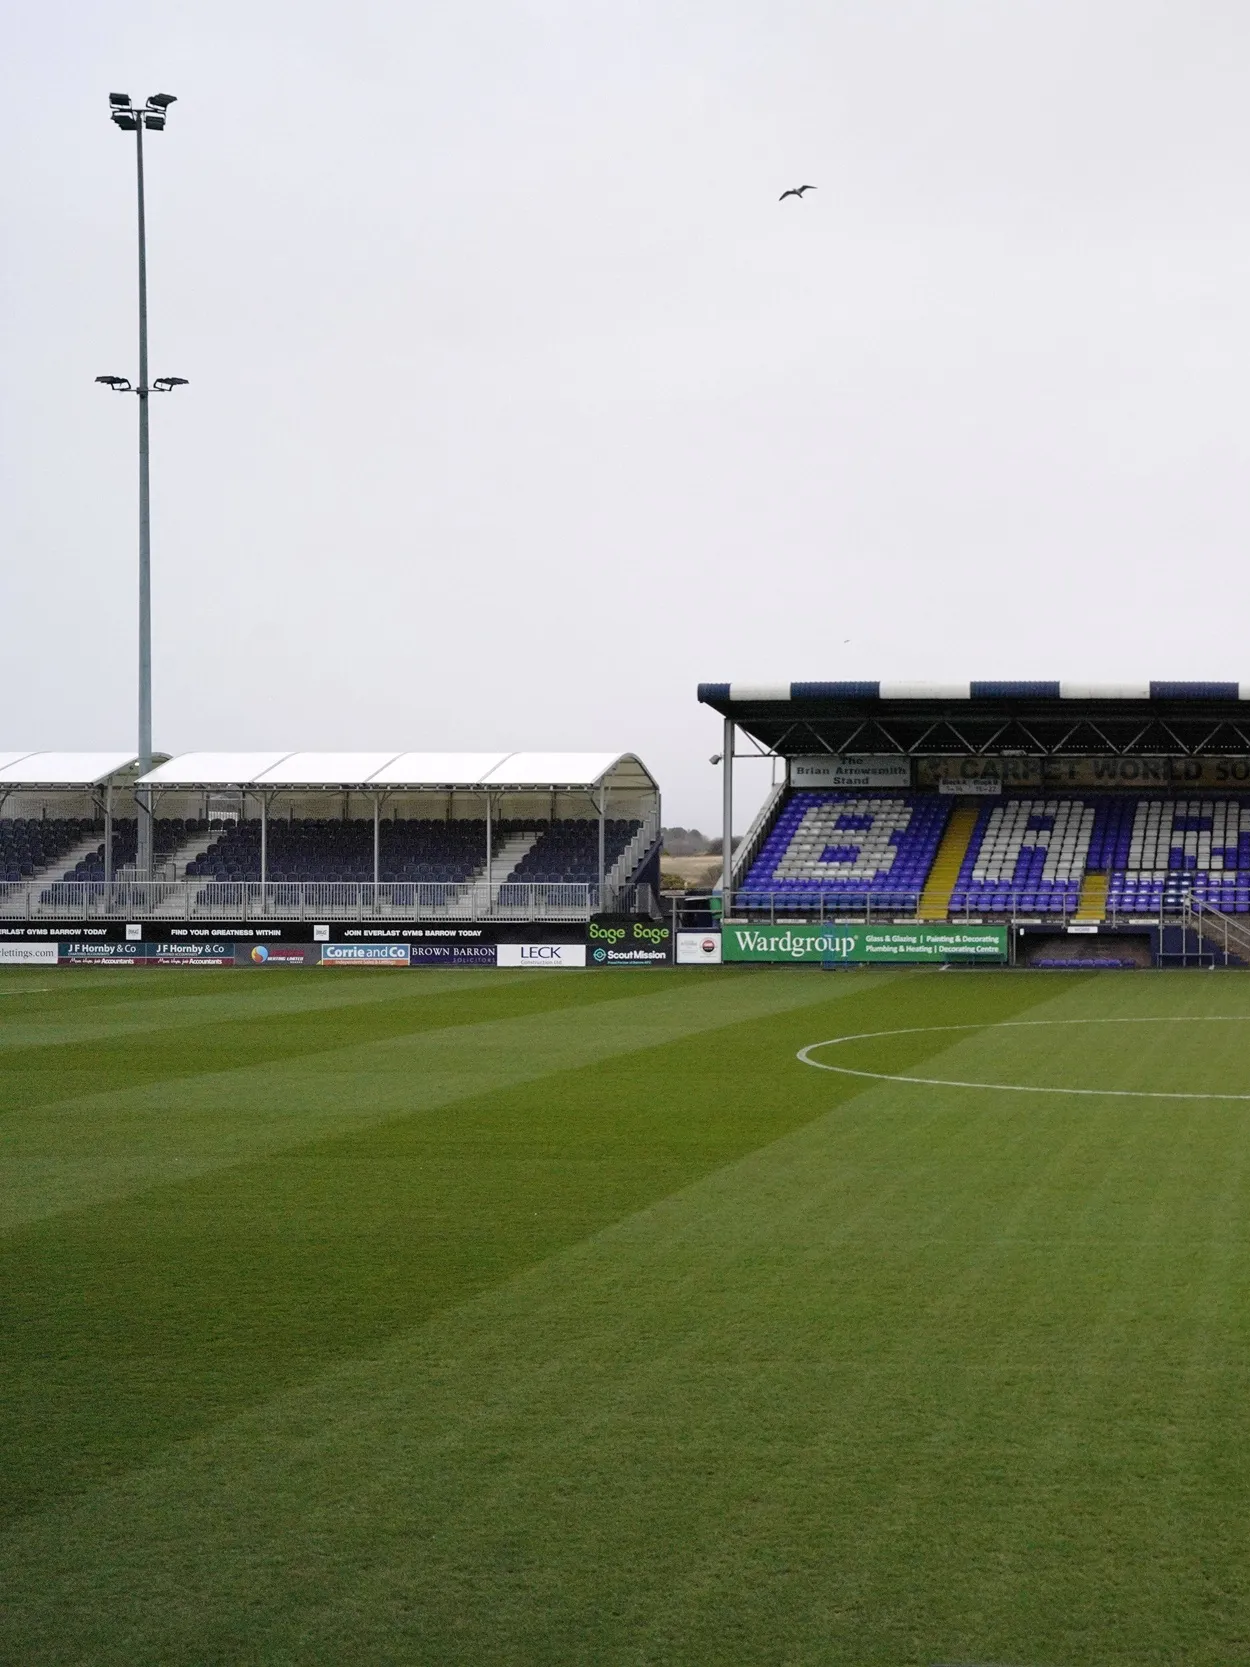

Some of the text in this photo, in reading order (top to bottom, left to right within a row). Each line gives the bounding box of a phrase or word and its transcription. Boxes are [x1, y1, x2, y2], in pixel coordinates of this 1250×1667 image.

[796, 766, 907, 775] Brian Arrowsmith
[833, 776, 870, 785] Stand
[26, 928, 48, 936] GYMS
[49, 928, 82, 936] BARROW
[84, 928, 108, 936] TODAY
[589, 923, 669, 944] Sage Sage
[735, 930, 856, 958] Wardgroup
[865, 935, 1000, 944] Glass & Glazing Painting & Decorating
[0, 948, 54, 960] lettings.com
[68, 944, 137, 955] J F Hornby & Co
[156, 944, 225, 955] J F Hornby & Co
[326, 946, 406, 958] Corrie and Co
[411, 947, 496, 956] BROWN BARRON
[520, 946, 562, 959] LECK
[865, 945, 999, 954] Plumbing & Heating Decorating Centre
[188, 957, 223, 965] Accountants
